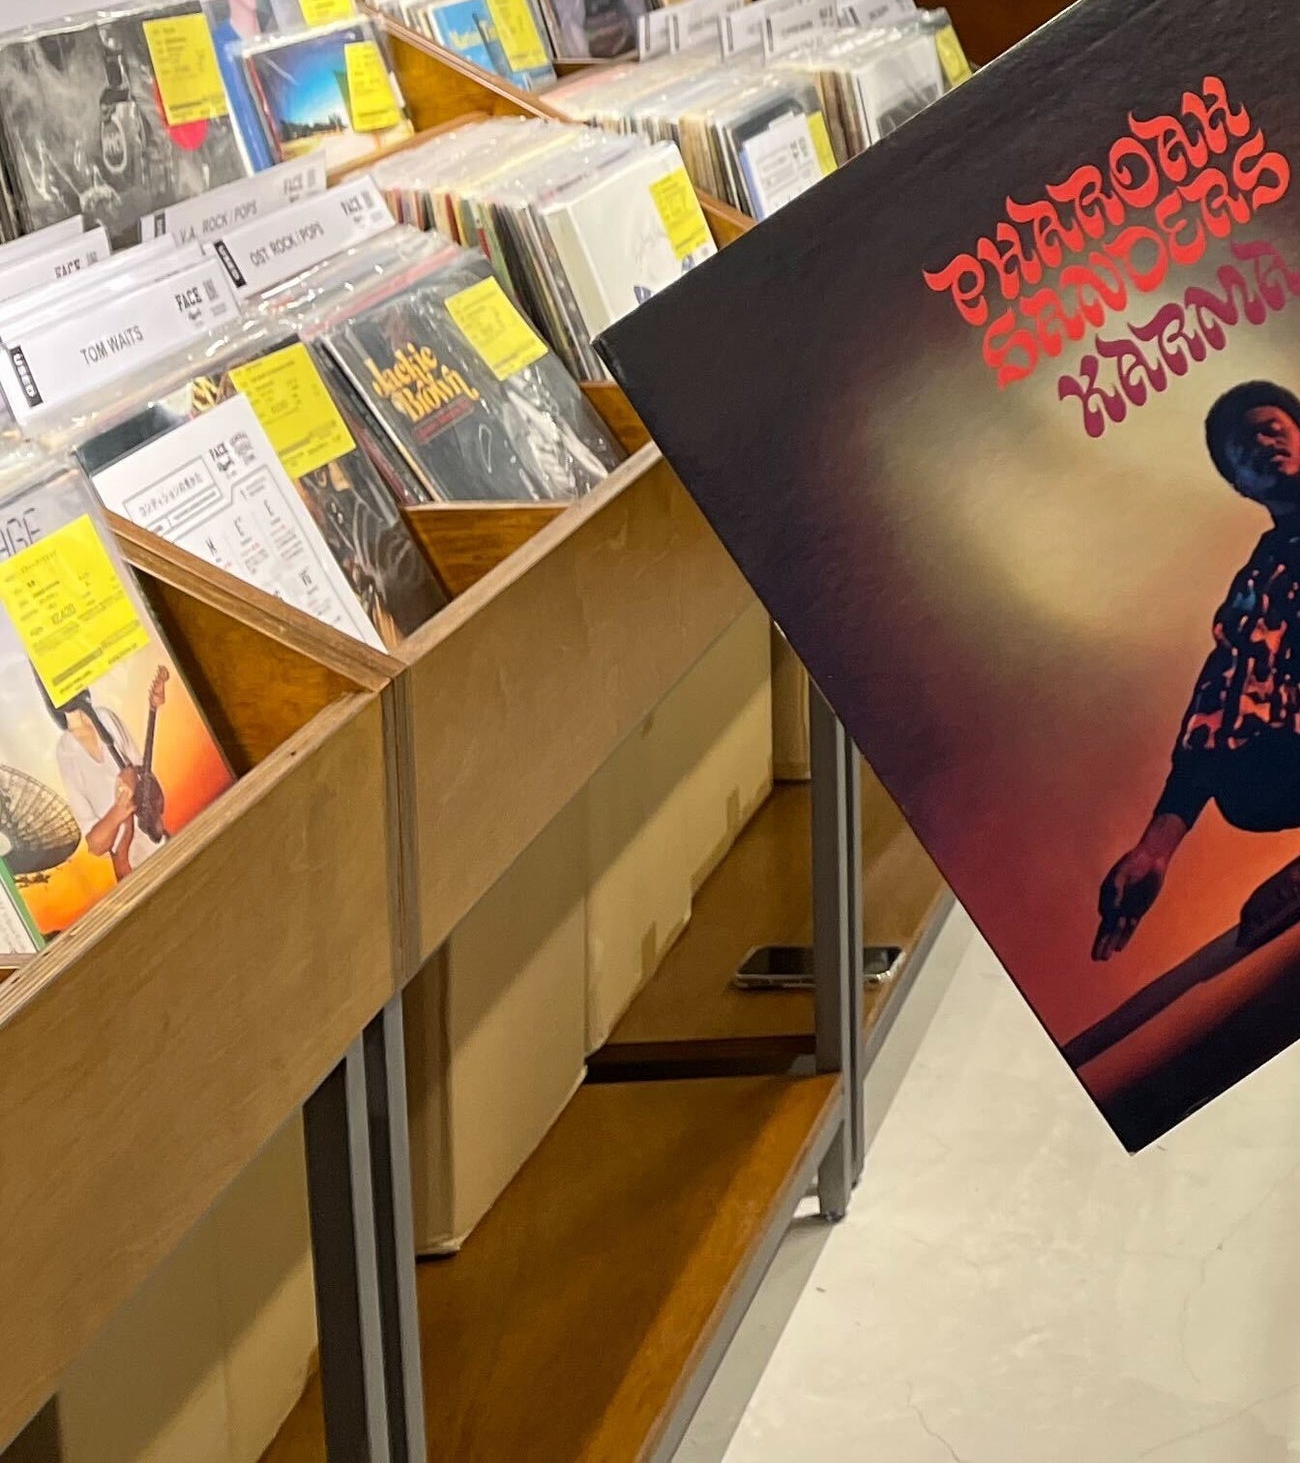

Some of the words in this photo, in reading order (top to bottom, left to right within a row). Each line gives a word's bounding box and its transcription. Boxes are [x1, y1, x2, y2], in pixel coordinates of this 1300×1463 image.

[203, 212, 228, 234] ROCK
[234, 199, 258, 221] POPS
[271, 234, 298, 258] ROCK
[300, 222, 325, 243] POPS
[983, 129, 1290, 390] SANDERS
[175, 287, 203, 313] FACE
[81, 344, 107, 365] TOM
[107, 325, 144, 354] WAITS
[364, 342, 438, 399] Jackie
[392, 364, 480, 422] Brown
